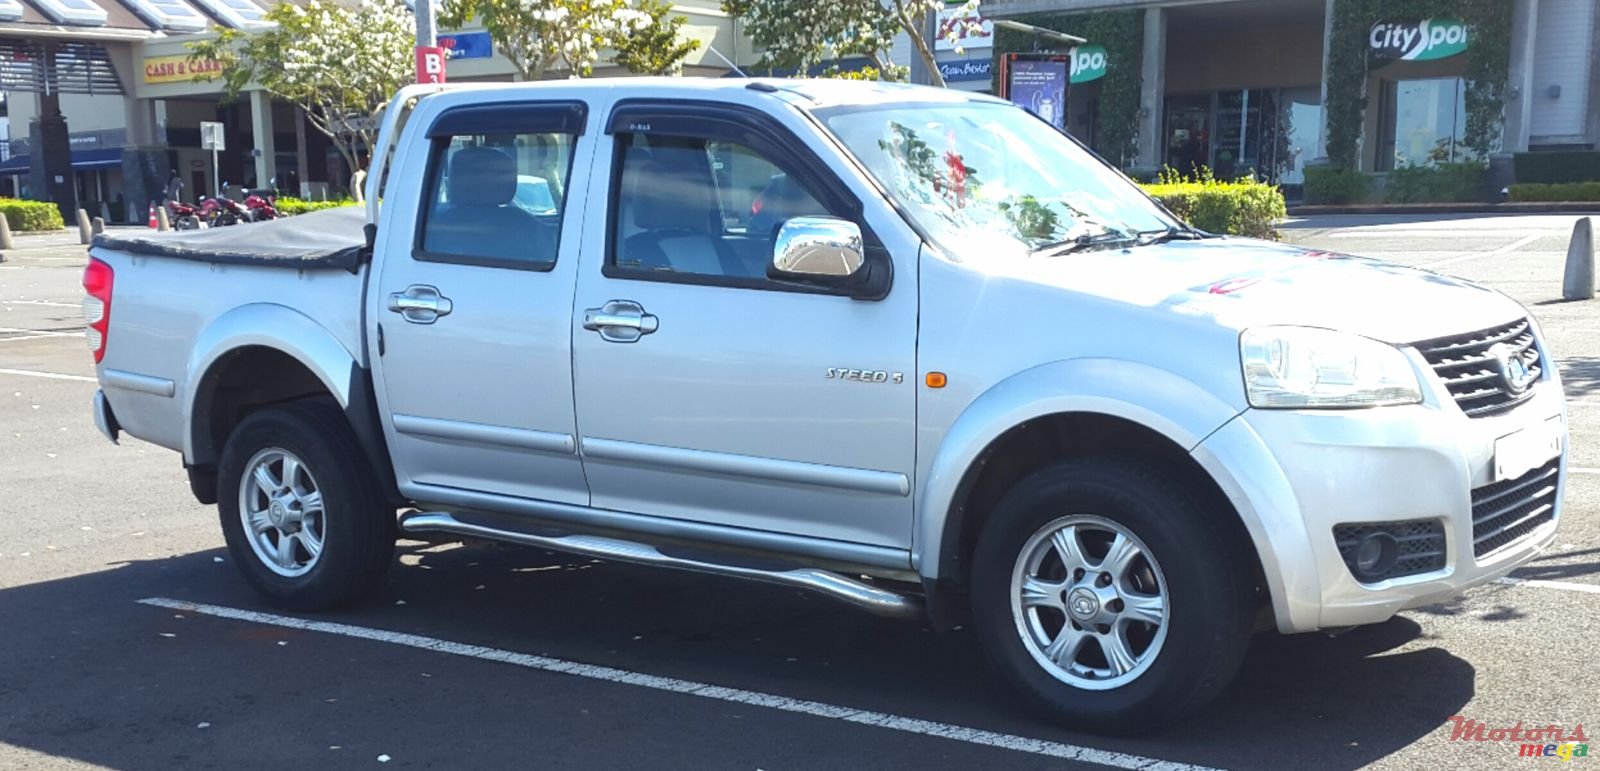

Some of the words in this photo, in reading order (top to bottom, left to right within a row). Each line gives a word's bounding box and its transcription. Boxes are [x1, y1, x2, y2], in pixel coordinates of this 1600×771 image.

[935, 17, 991, 40] KFC
[146, 63, 175, 77] CASH
[178, 62, 185, 74] &
[188, 59, 221, 73] CARR
[424, 53, 441, 74] B
[941, 64, 963, 79] Ocean
[964, 62, 991, 75] Basket
[430, 74, 439, 84] 3
[825, 367, 888, 382] STEED
[892, 371, 904, 384] 5
